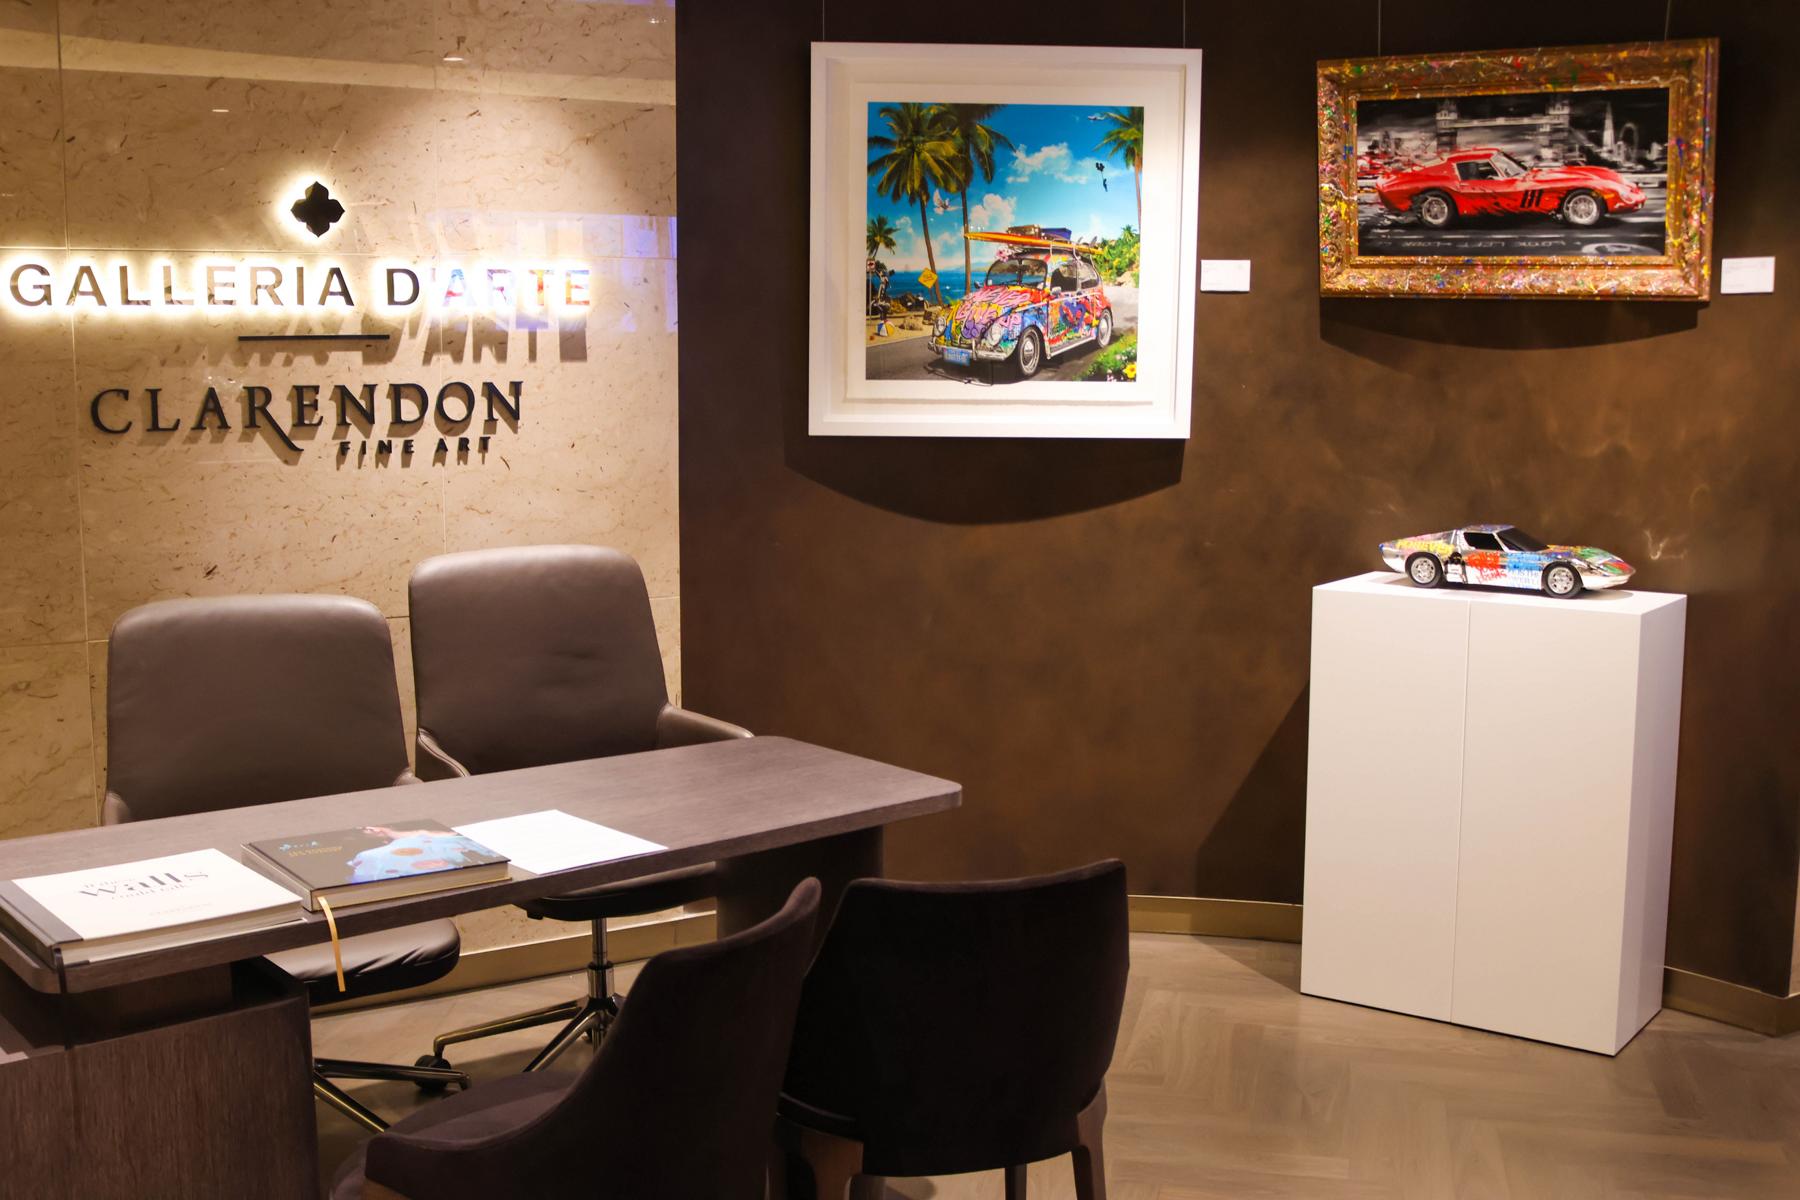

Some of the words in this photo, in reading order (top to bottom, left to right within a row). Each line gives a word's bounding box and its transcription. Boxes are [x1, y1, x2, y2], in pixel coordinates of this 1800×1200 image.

[10, 263, 355, 307] GALLERIA
[386, 267, 590, 306] D'ARTE
[955, 302, 998, 325] GIVE
[998, 313, 1021, 331] UP
[91, 380, 523, 452] CLARENDON
[339, 439, 414, 456] FINE
[435, 436, 491, 454] ART
